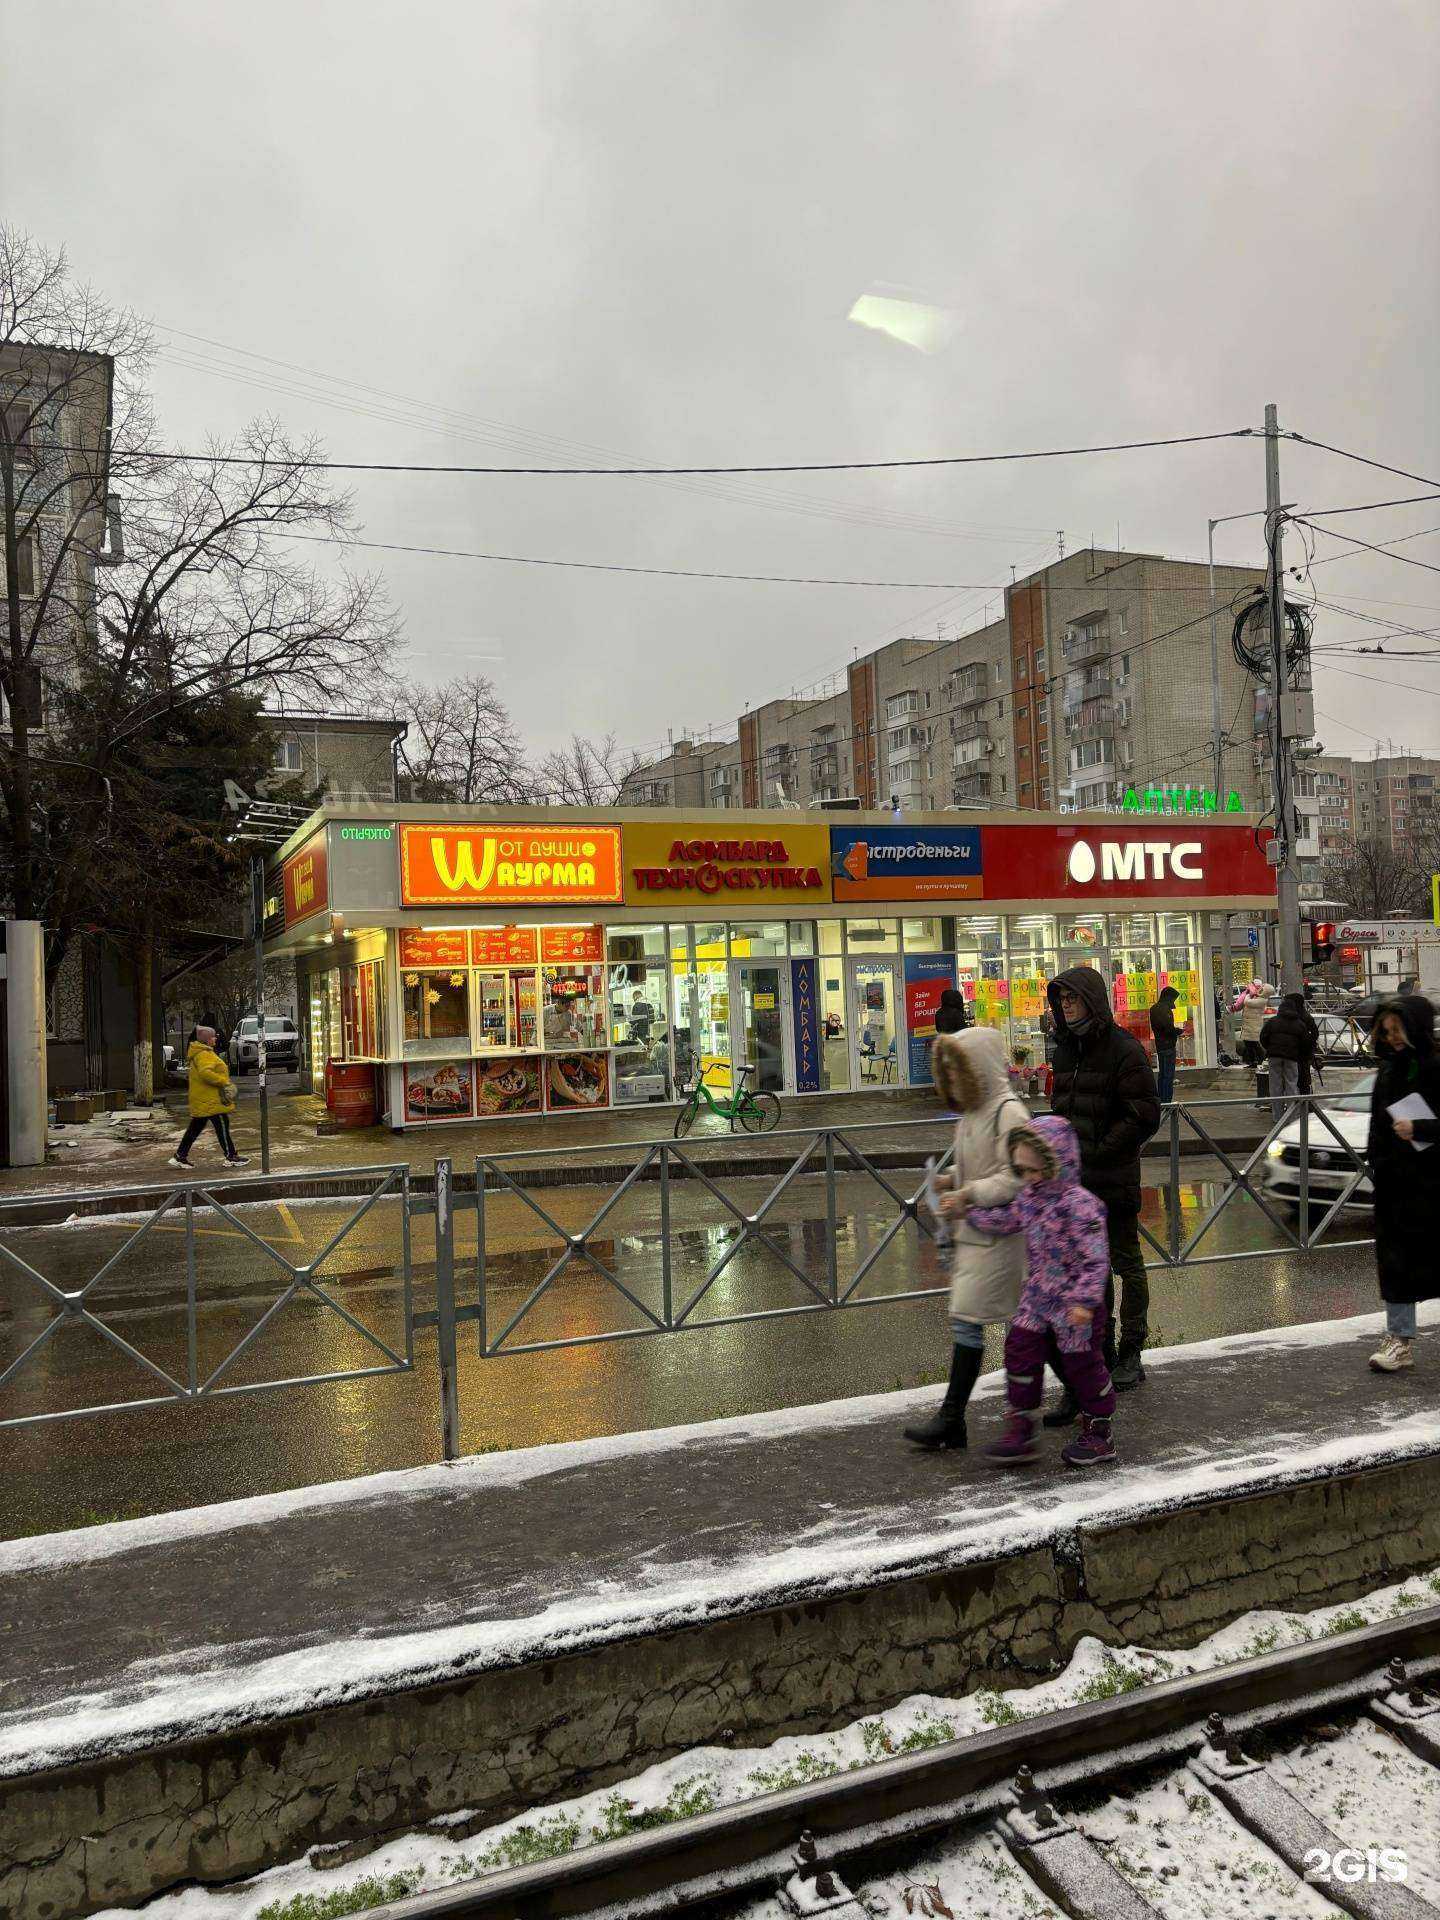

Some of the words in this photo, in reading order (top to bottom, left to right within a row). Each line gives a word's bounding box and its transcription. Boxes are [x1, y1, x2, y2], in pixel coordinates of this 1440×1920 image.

[1122, 787, 1246, 814] АПТЕКА
[500, 841, 524, 857] ОТ
[529, 841, 581, 858] ДУШИ
[668, 839, 790, 862] ЛОМБАРД
[1101, 842, 1203, 881] МТС
[631, 861, 824, 895] ТЕХНОСКУПКА
[967, 981, 1047, 995] РАССРОЧК
[1118, 973, 1197, 987] СМАРТФОН
